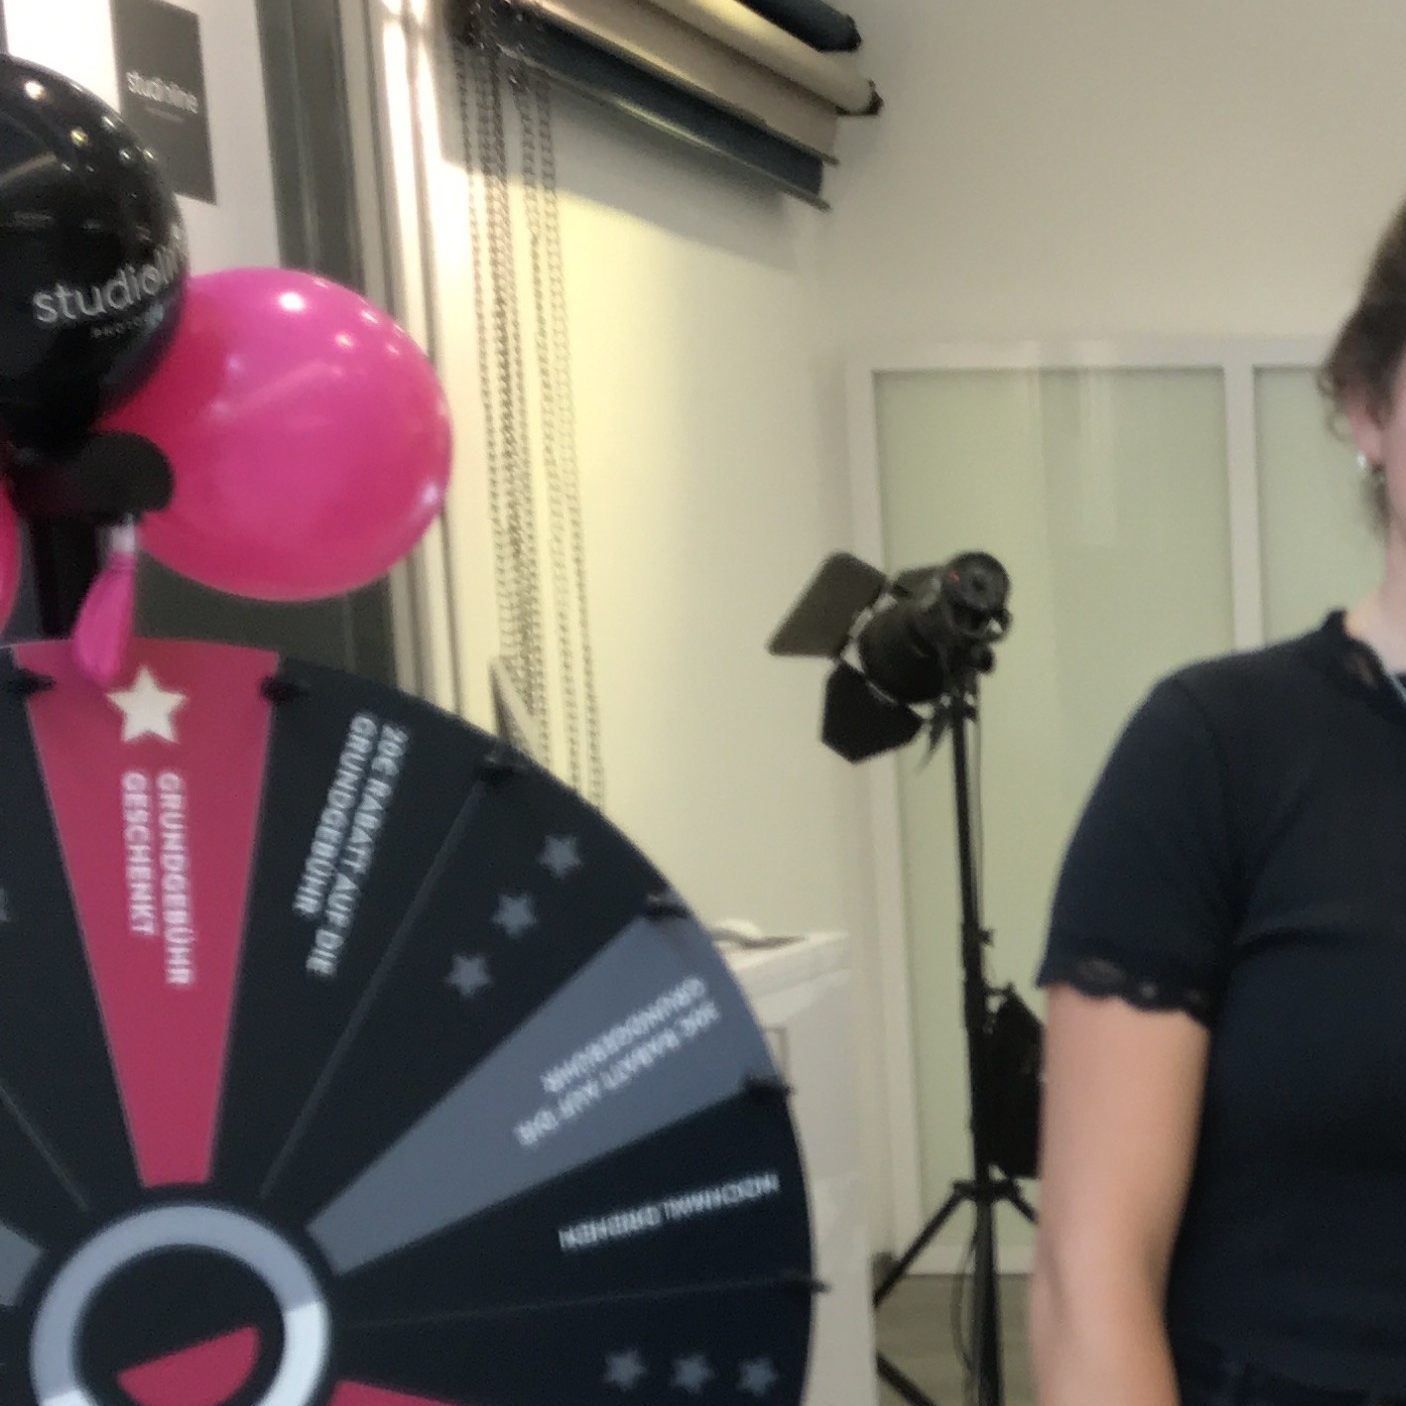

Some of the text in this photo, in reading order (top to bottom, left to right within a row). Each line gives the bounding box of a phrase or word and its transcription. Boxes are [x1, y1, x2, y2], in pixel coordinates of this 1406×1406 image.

[122, 772, 155, 935] GESCHENKT
[157, 772, 194, 985] GRUNDGEBÜHR
[294, 715, 377, 914] GRUNDGEBÜHR
[342, 777, 392, 874] RABATT
[306, 928, 344, 975] DIE
[325, 872, 358, 928] AUF
